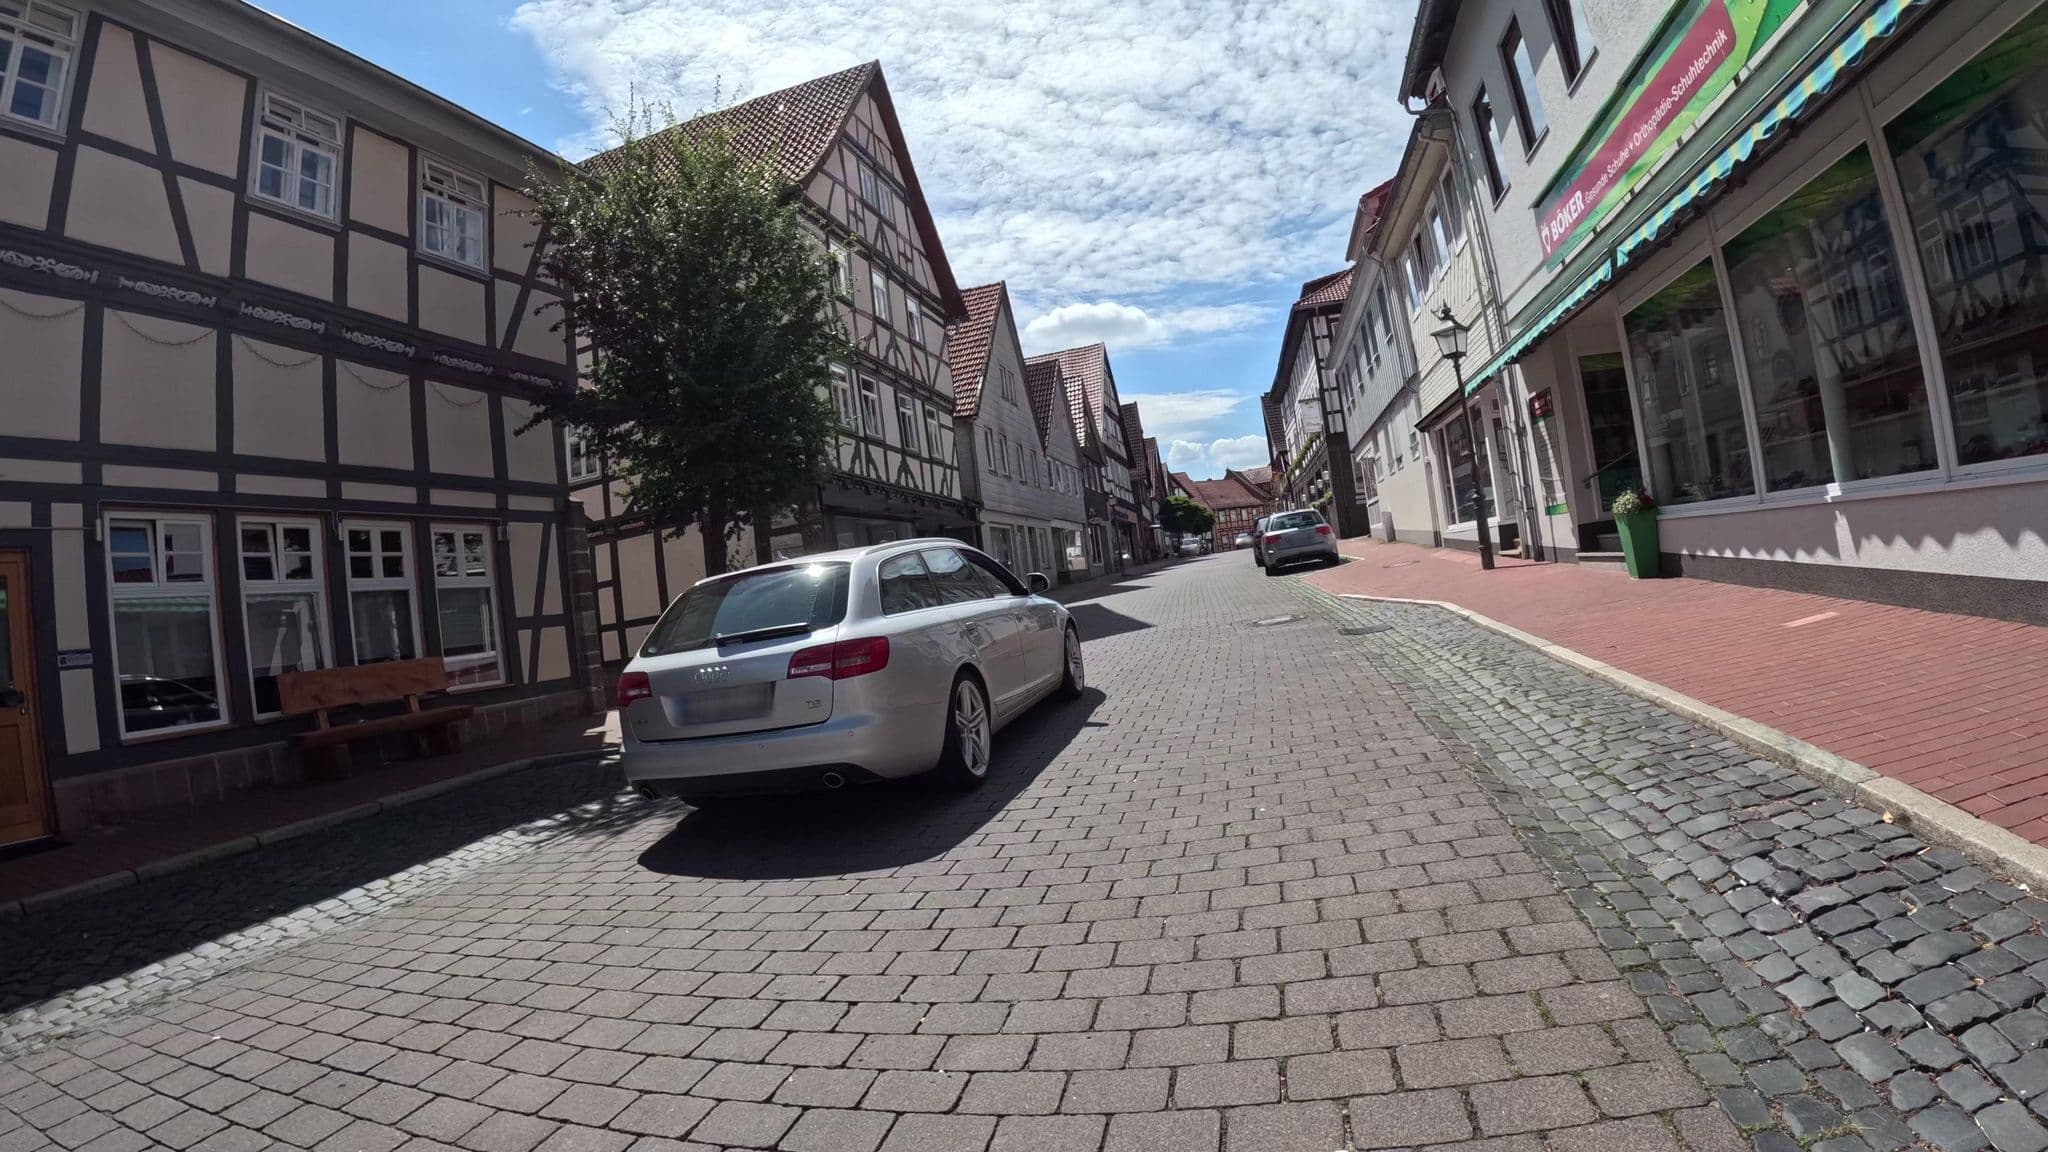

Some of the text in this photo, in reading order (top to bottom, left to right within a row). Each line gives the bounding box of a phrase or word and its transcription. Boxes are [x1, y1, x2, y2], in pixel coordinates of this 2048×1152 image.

[1550, 190, 1585, 241] BÖKER
[1585, 173, 1608, 204] Gesunde
[1607, 146, 1629, 178] Schuhe
[1633, 28, 1728, 147] Orthopädie-Schuhtechnik
